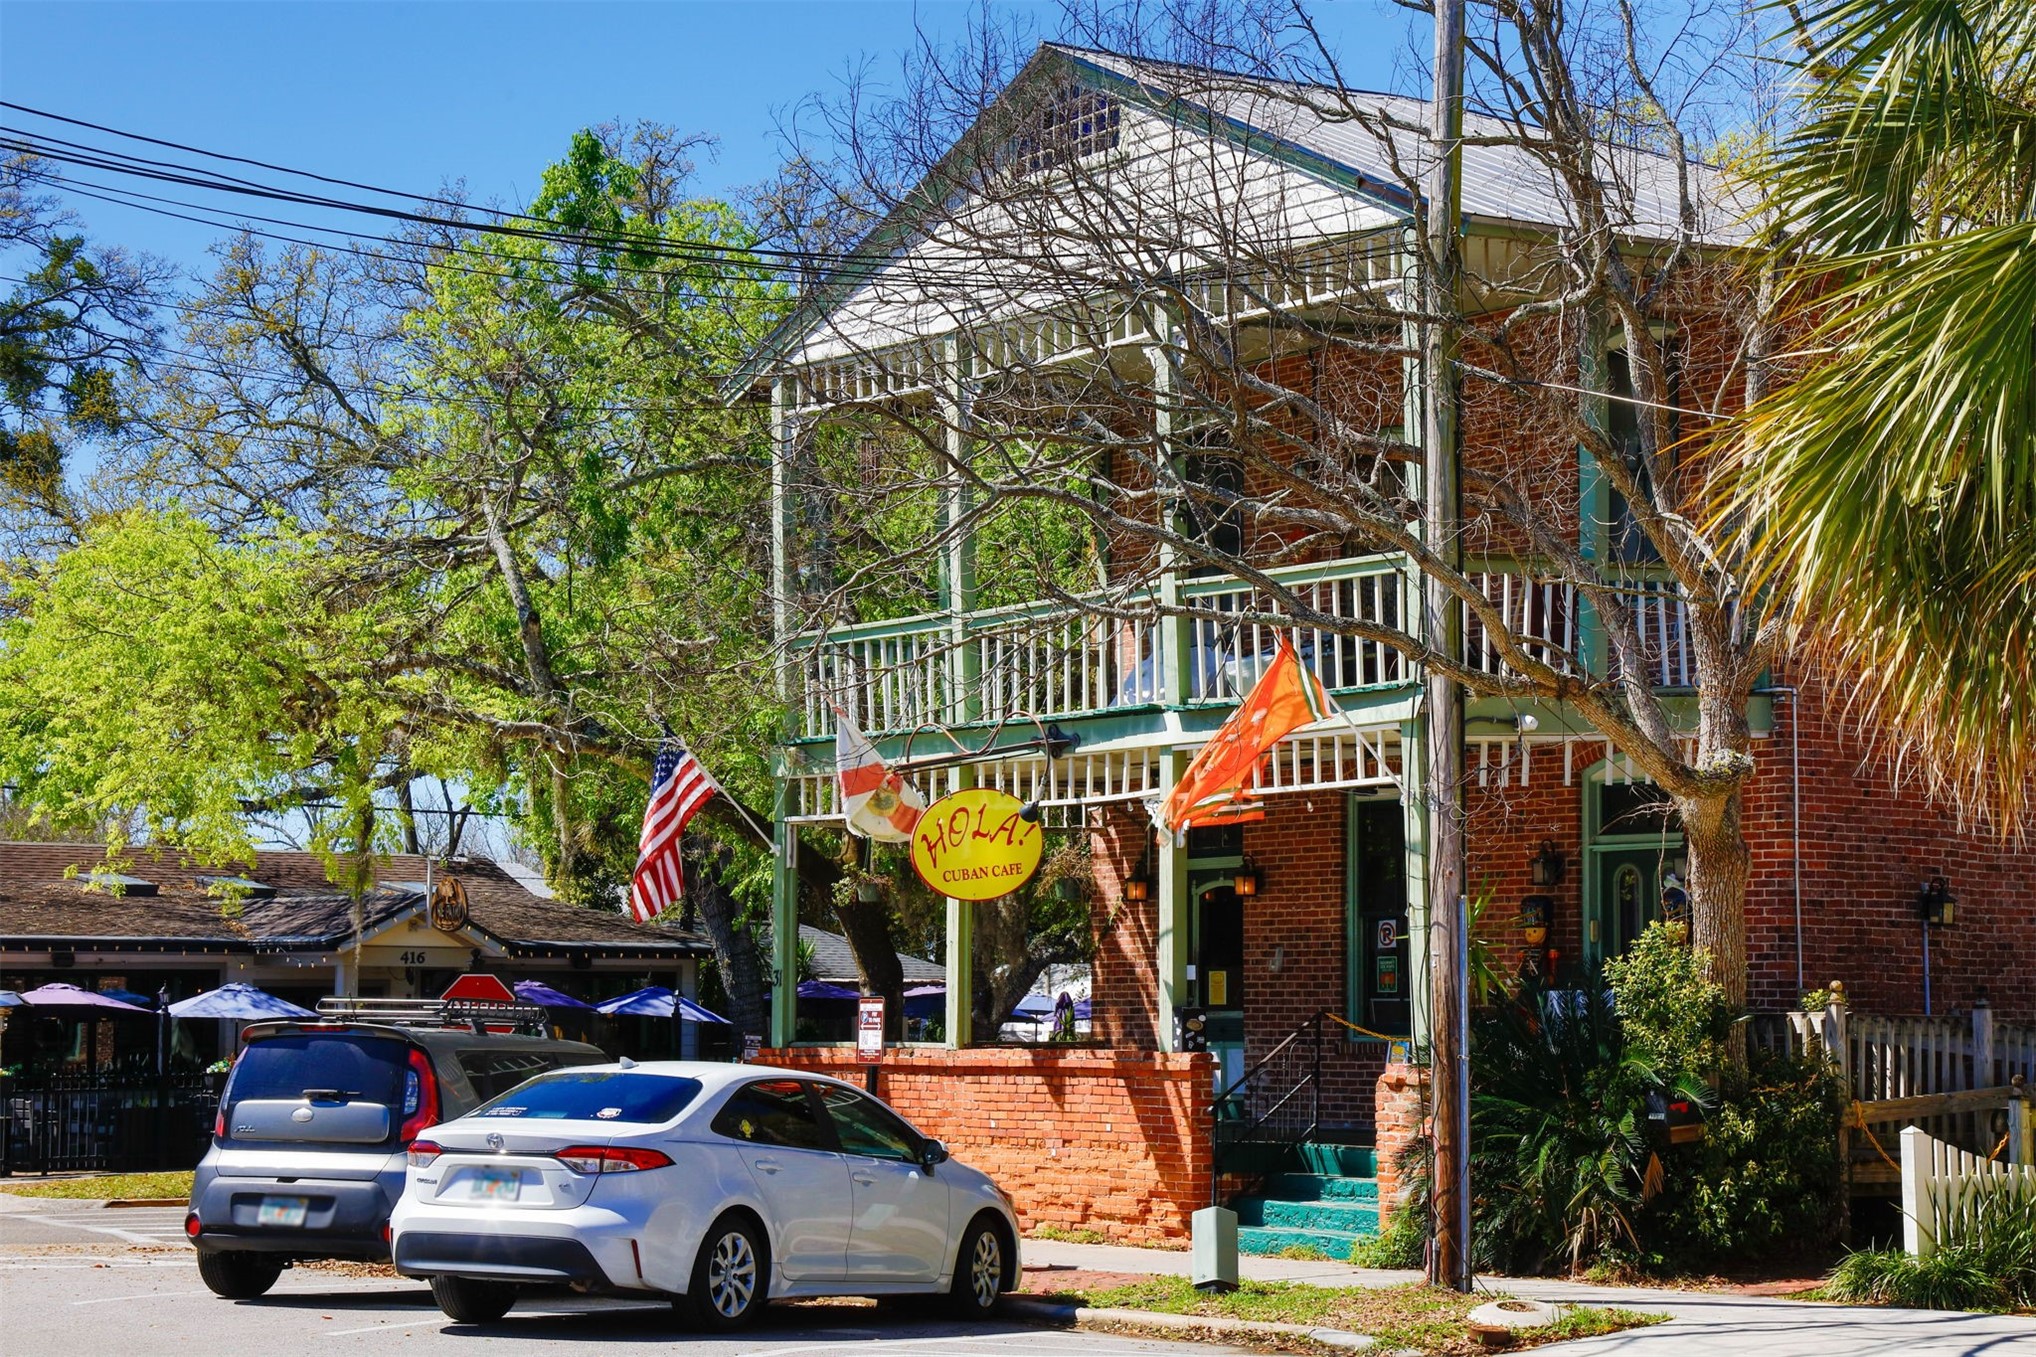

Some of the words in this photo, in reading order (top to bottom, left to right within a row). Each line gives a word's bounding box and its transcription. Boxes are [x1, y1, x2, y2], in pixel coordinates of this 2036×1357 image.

[921, 803, 1036, 869] HOLA!
[942, 866, 989, 883] CUBAN
[992, 862, 1023, 878] CAFE
[399, 951, 426, 965] 416
